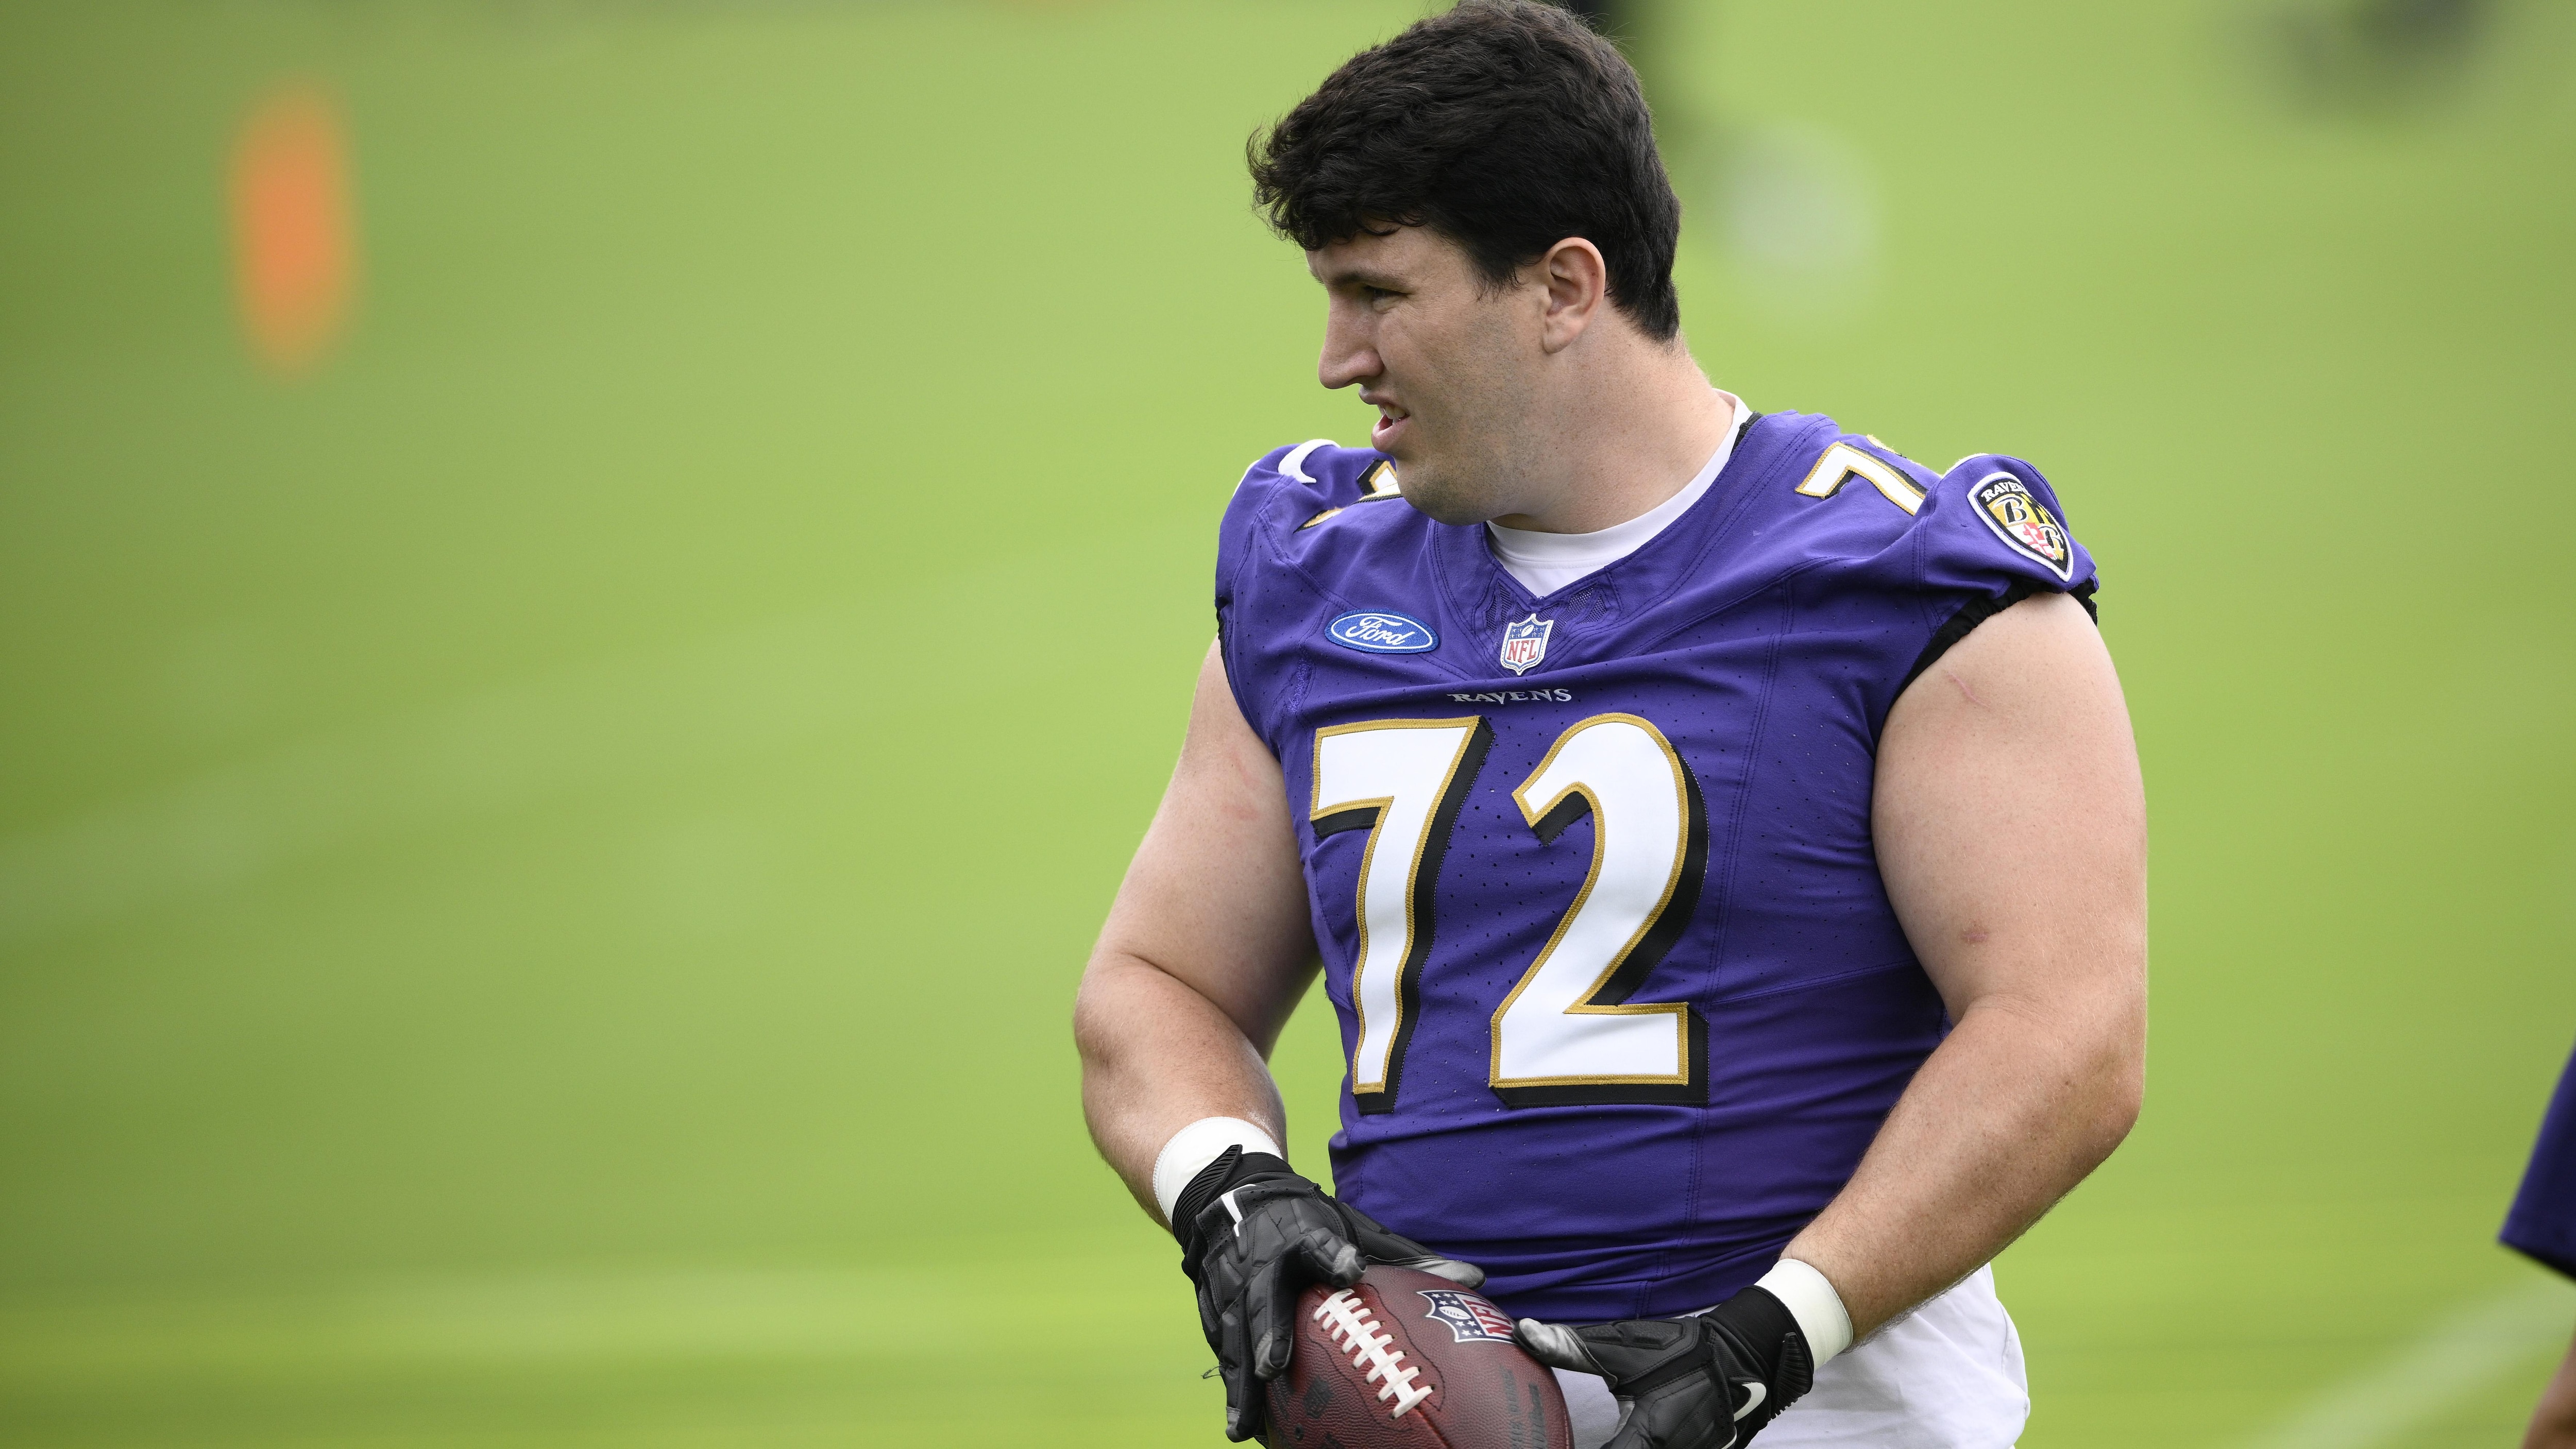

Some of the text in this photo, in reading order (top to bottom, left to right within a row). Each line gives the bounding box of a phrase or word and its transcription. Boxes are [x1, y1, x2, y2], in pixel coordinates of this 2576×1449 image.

[1992, 496, 2028, 526] B
[1345, 616, 1415, 645] Ford
[1506, 640, 1536, 663] NFL
[1447, 688, 1572, 705] RAVENS
[1311, 712, 1709, 1114] 72
[1462, 1294, 1514, 1336] NFL
